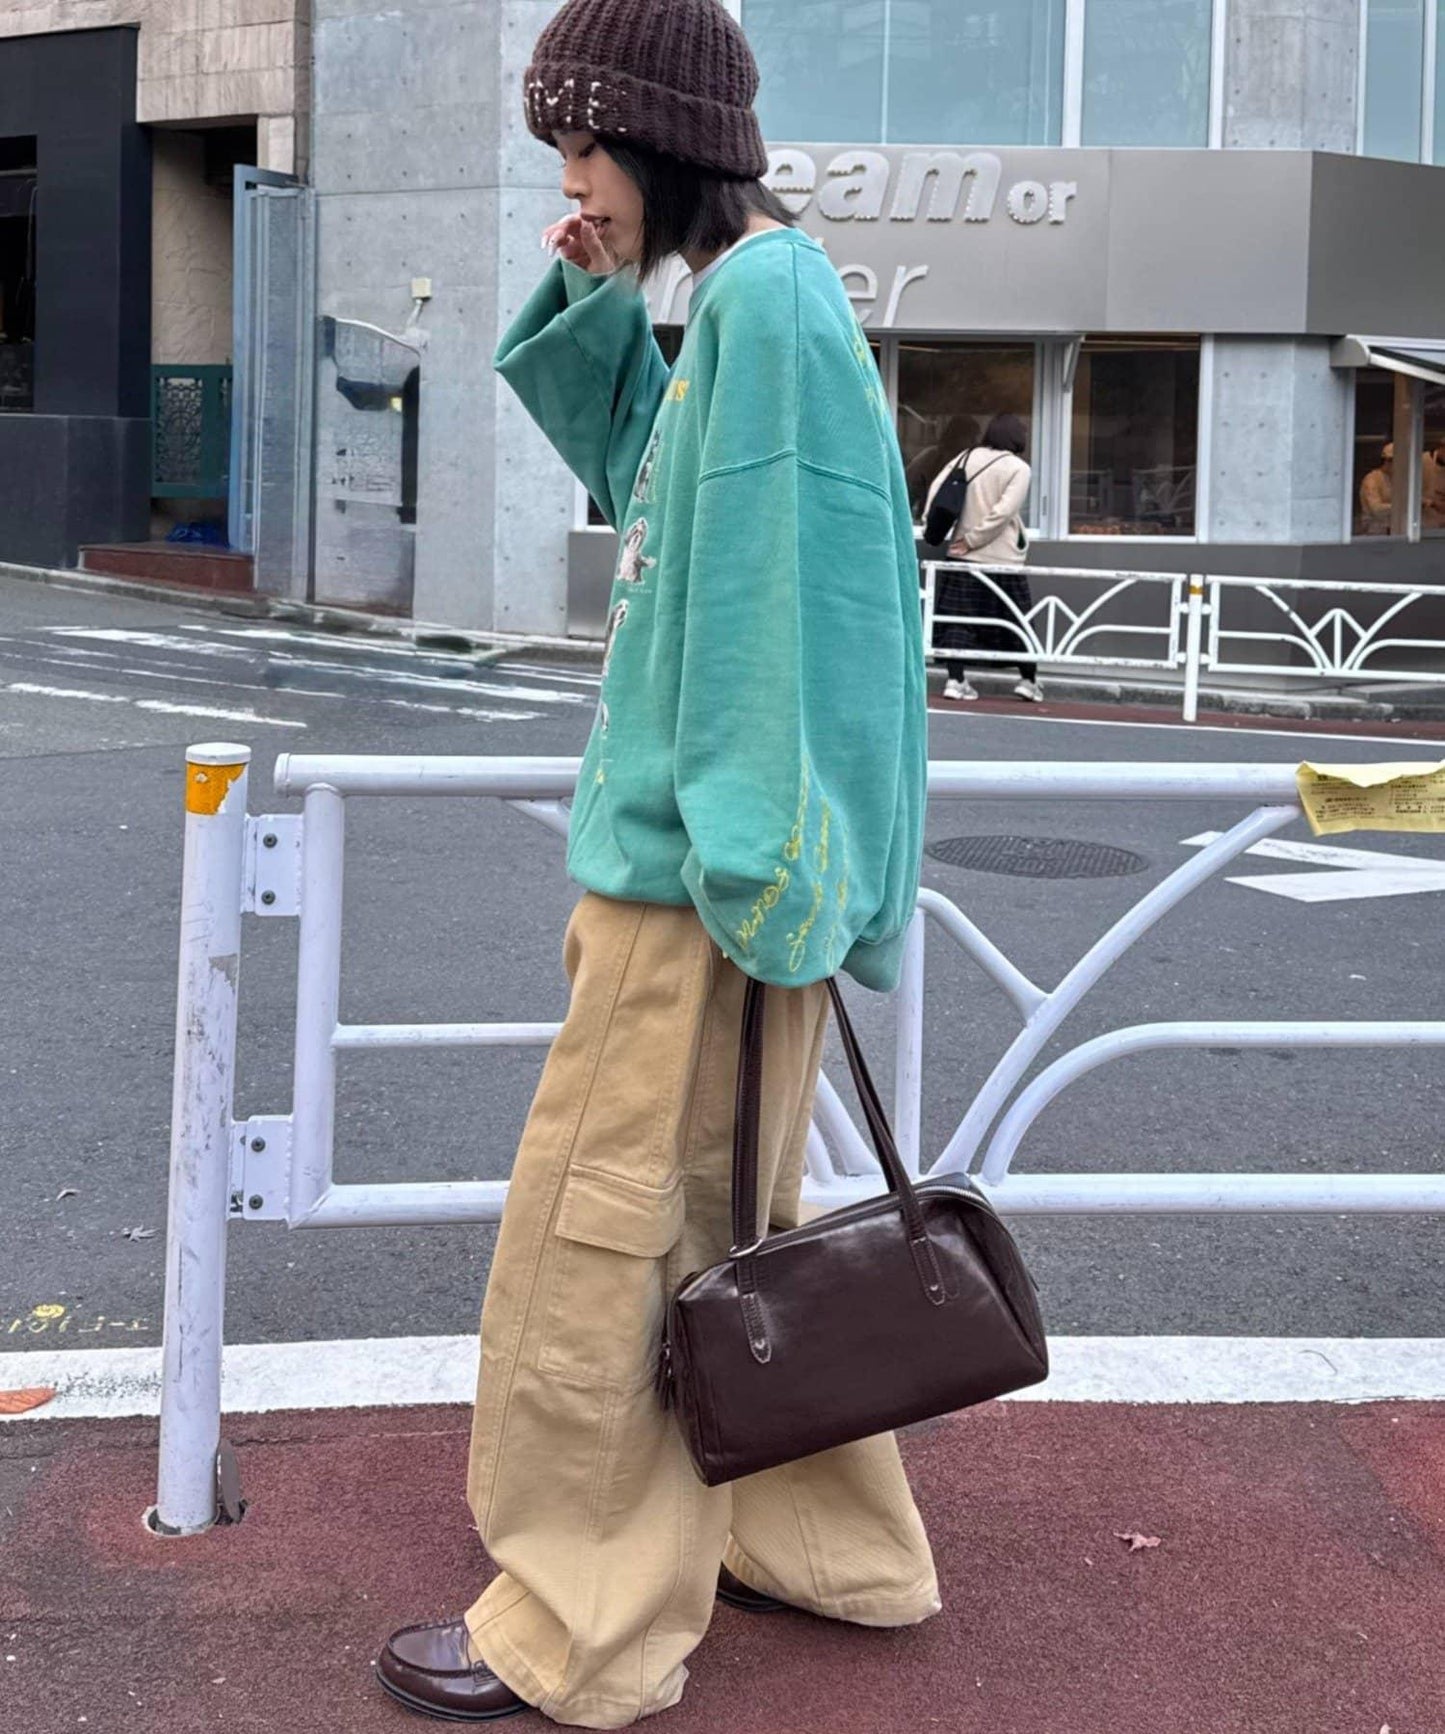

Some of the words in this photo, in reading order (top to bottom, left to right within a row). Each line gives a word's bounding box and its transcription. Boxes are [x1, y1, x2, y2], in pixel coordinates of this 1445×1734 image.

[524, 78, 628, 132] ME
[764, 148, 1000, 222] eam
[1006, 179, 1077, 225] or
